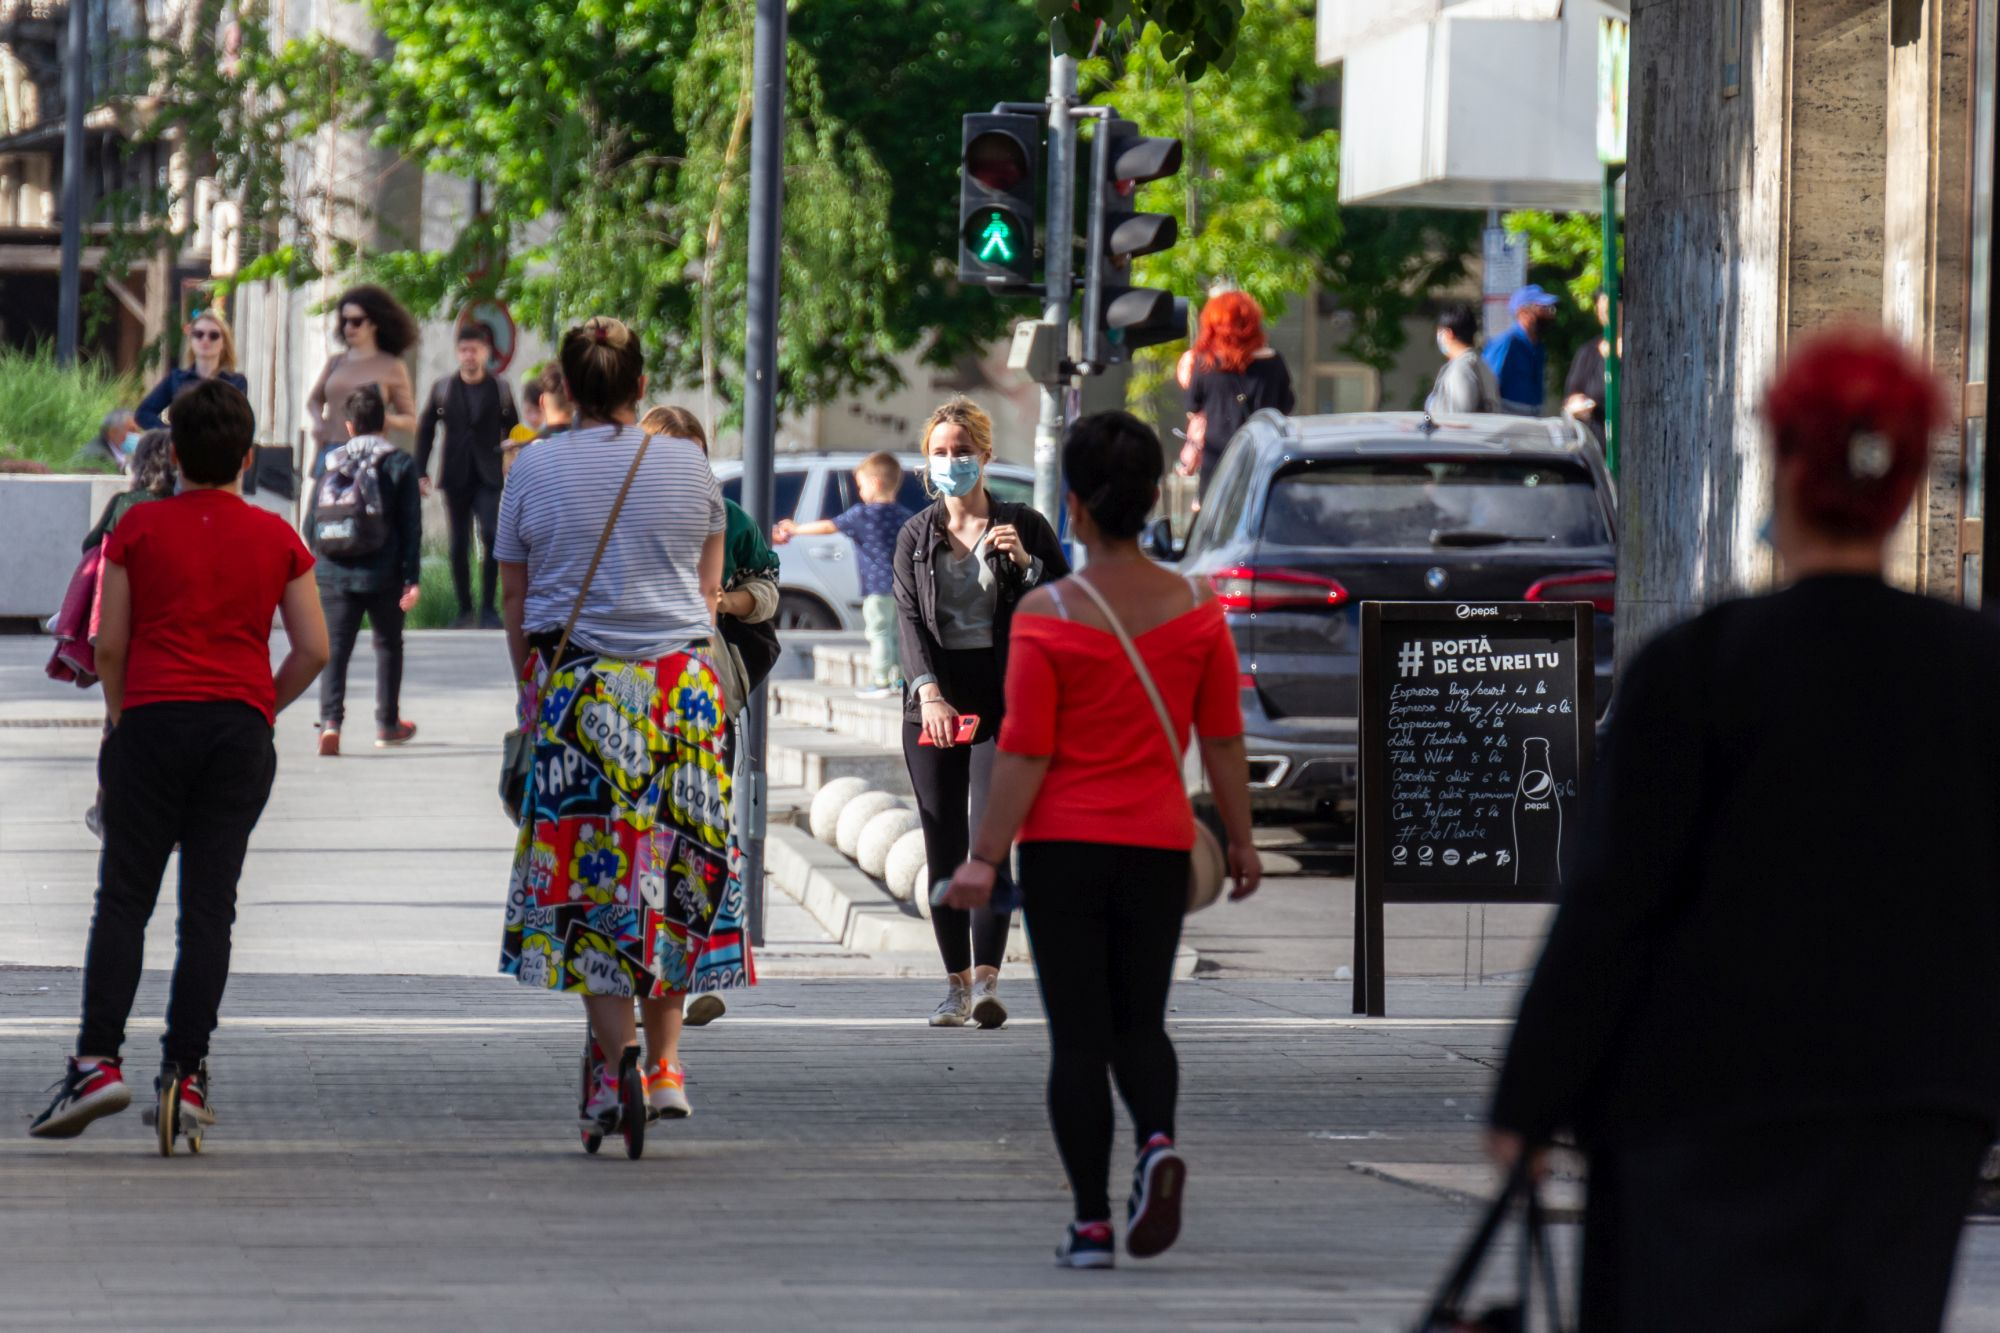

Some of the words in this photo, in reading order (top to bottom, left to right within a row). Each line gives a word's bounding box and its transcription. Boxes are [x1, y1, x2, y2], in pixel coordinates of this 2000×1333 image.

[1470, 606, 1499, 617] pepsi
[1432, 634, 1493, 656] POFTĂ
[1433, 658, 1458, 675] DE
[1462, 656, 1487, 673] CE
[1491, 653, 1531, 671] VREI
[1534, 652, 1560, 668] TU
[1390, 683, 1440, 701] Espresso
[1515, 683, 1528, 696] 4
[1535, 680, 1549, 694] lei
[1389, 701, 1437, 718] Espresso
[1546, 704, 1558, 714] 6
[1559, 698, 1573, 714] lei
[1388, 716, 1452, 740] Cappuccino
[1475, 719, 1488, 729] 6
[1471, 752, 1480, 764] 8
[1474, 807, 1485, 818] 5
[1524, 801, 1550, 812] pepsi
